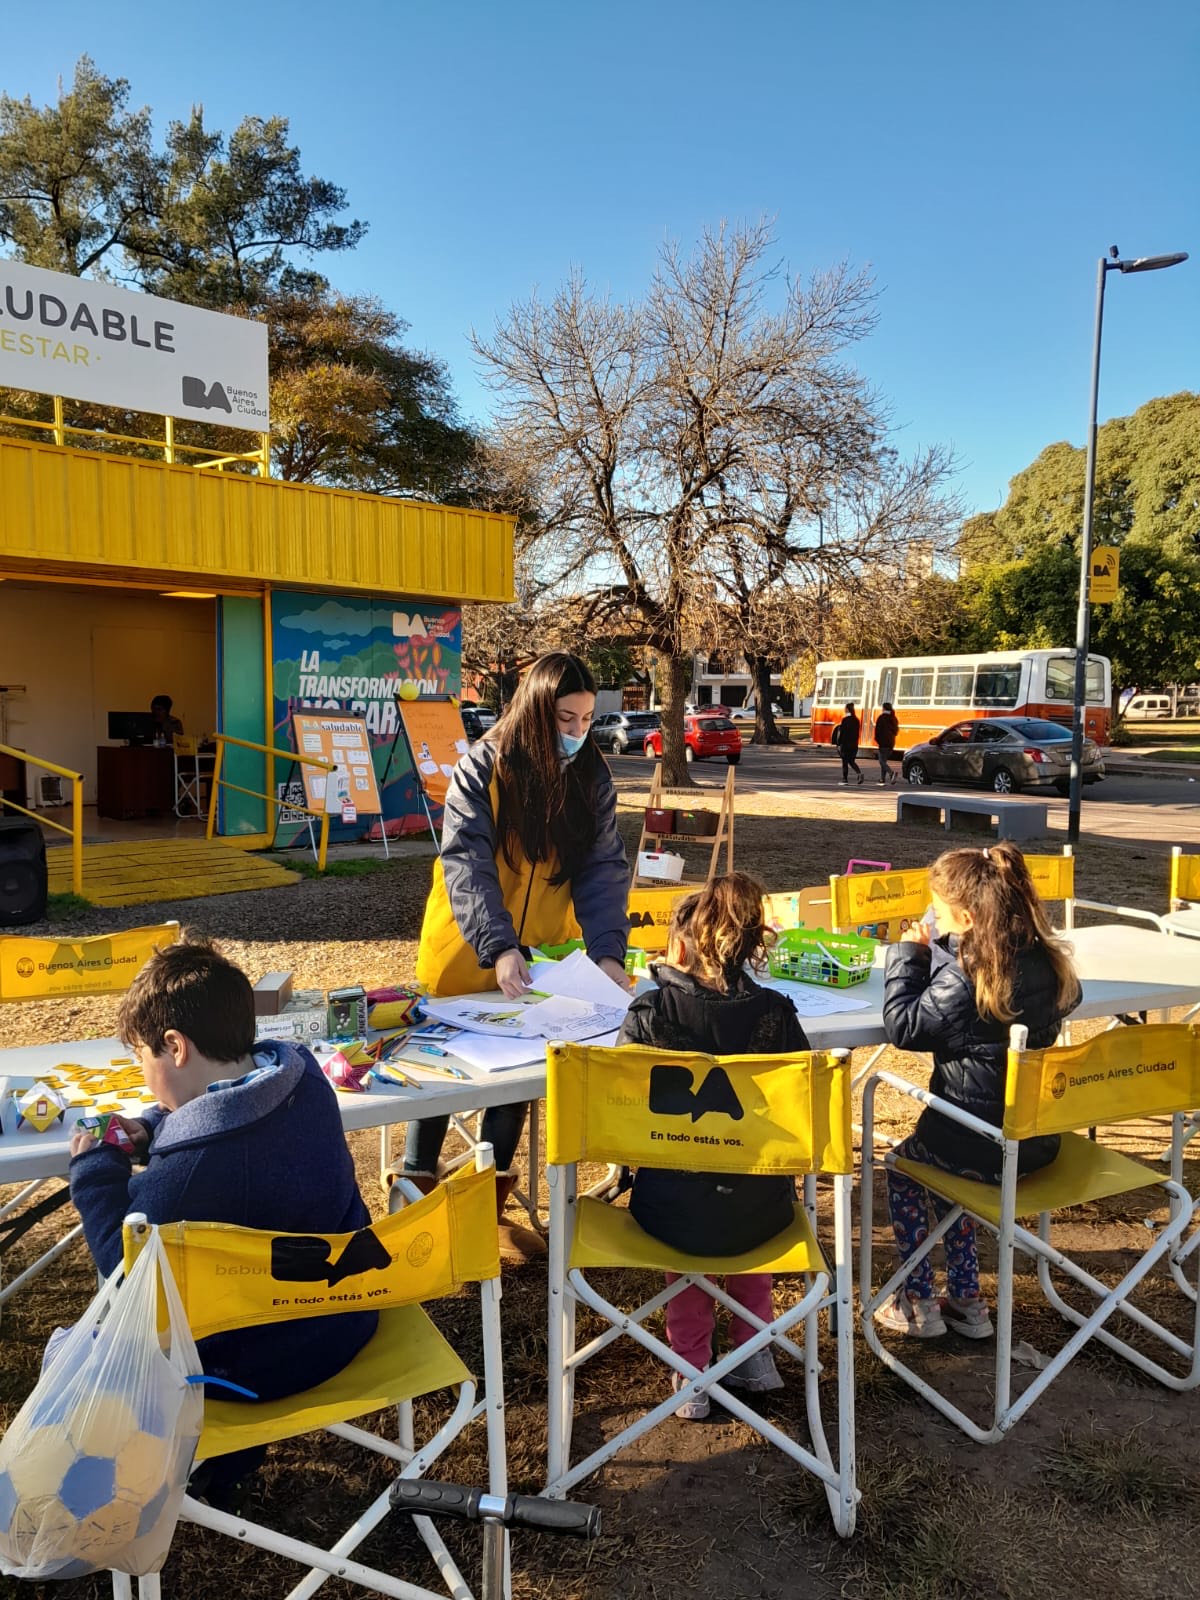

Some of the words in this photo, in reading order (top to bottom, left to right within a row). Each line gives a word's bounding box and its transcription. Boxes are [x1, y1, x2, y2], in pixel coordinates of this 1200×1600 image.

[0, 285, 176, 354] UDABLE
[182, 376, 232, 414] BA
[226, 385, 258, 399] Buenos
[231, 395, 256, 407] Aires
[236, 404, 268, 418] Ciudad
[1093, 564, 1111, 577] BA
[392, 611, 428, 639] BA
[300, 649, 320, 673] LA
[38, 961, 74, 971] Buenos
[77, 958, 101, 968] Aires
[103, 954, 137, 966] Ciudad
[1069, 1072, 1105, 1087] Buenos
[1107, 1067, 1134, 1080] Aires
[1136, 1060, 1175, 1074] Ciudad
[650, 1065, 744, 1123] BA
[650, 1131, 663, 1140] En
[667, 1132, 690, 1142] todo
[693, 1134, 720, 1145] estás
[723, 1137, 744, 1147] vos.
[271, 1228, 393, 1288] BA
[272, 1298, 284, 1306] En
[294, 1296, 325, 1305] todo
[329, 1291, 363, 1302] estás
[367, 1287, 392, 1298] vos.
